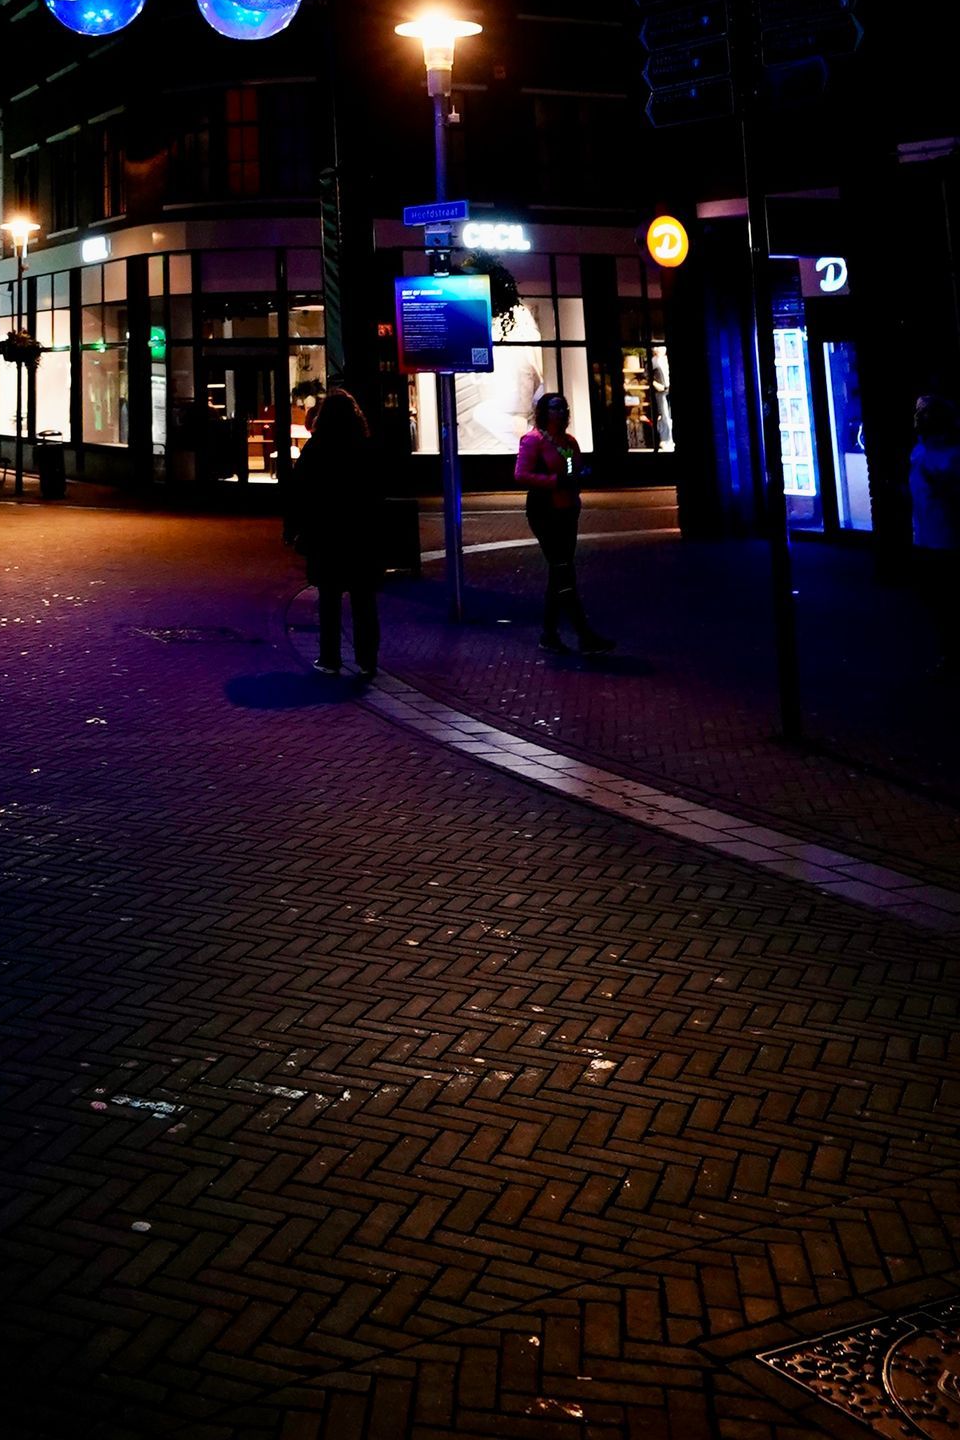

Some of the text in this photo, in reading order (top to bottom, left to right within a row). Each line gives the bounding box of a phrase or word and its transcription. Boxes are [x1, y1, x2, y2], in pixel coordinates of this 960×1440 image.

[411, 207, 458, 219] Hoofdstraat
[652, 223, 682, 259] D
[815, 257, 848, 292] D
